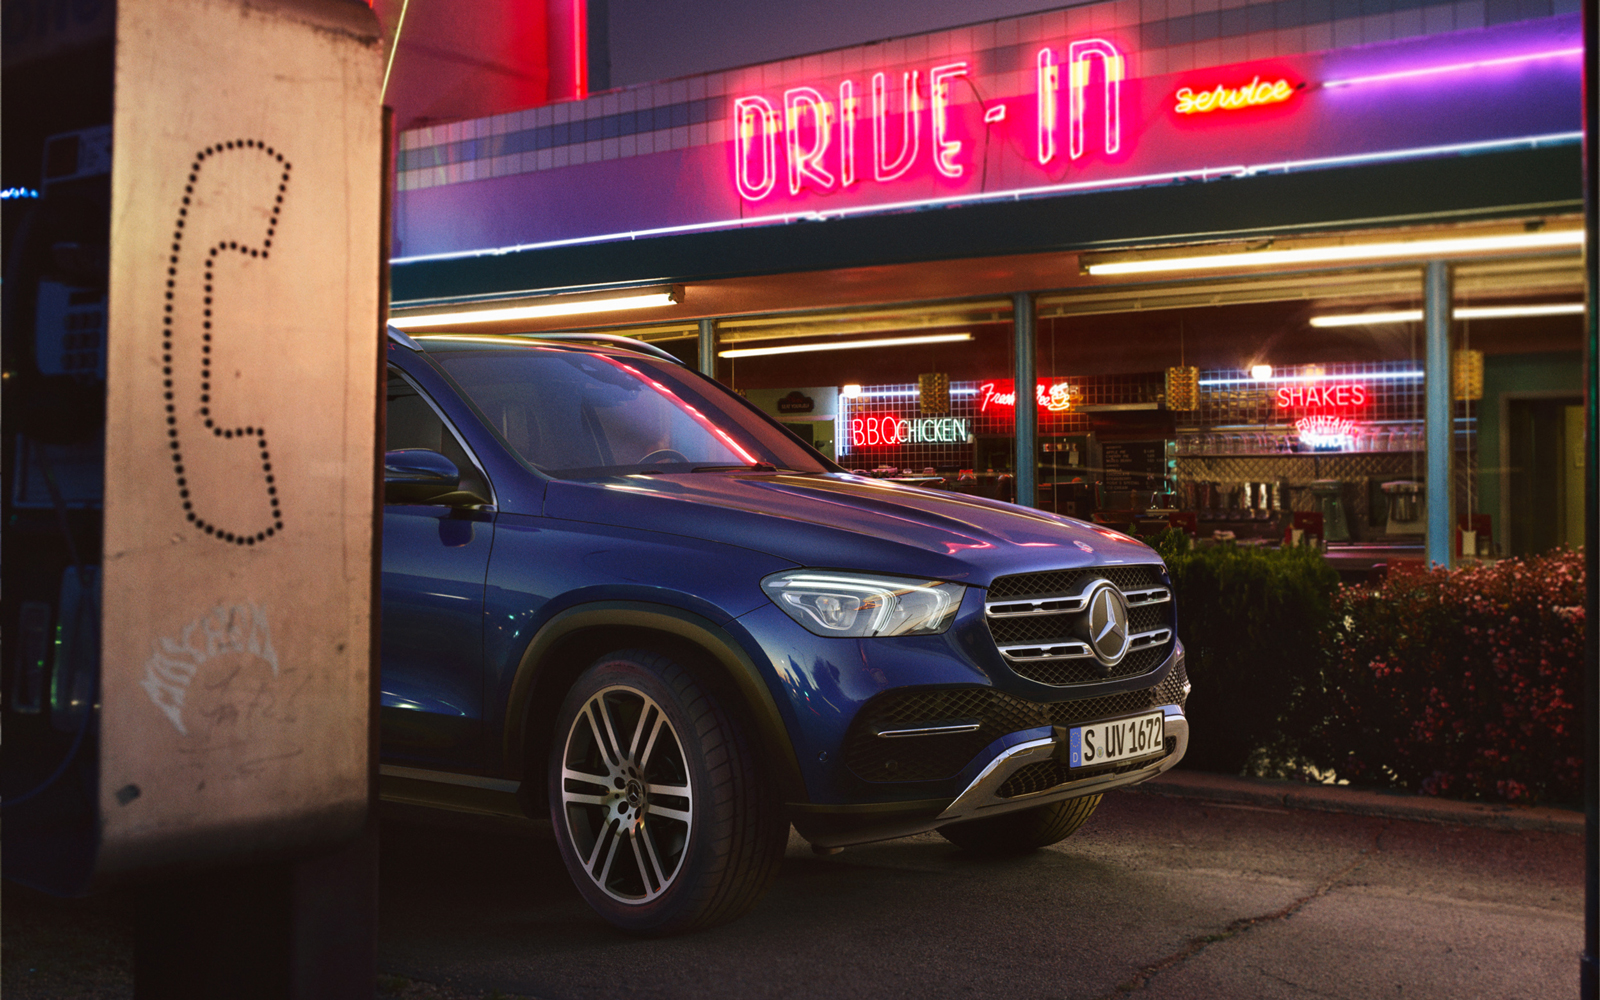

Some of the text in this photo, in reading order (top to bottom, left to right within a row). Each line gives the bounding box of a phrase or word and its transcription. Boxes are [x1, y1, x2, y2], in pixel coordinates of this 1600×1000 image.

[733, 38, 1296, 201] DRIVE-IN Service
[1277, 384, 1365, 408] SHAKES
[896, 418, 967, 443] CHICKEN
[1295, 415, 1354, 434] FOUNTAIN
[1084, 716, 1161, 762] S UV 1672
[1072, 752, 1079, 763] D
